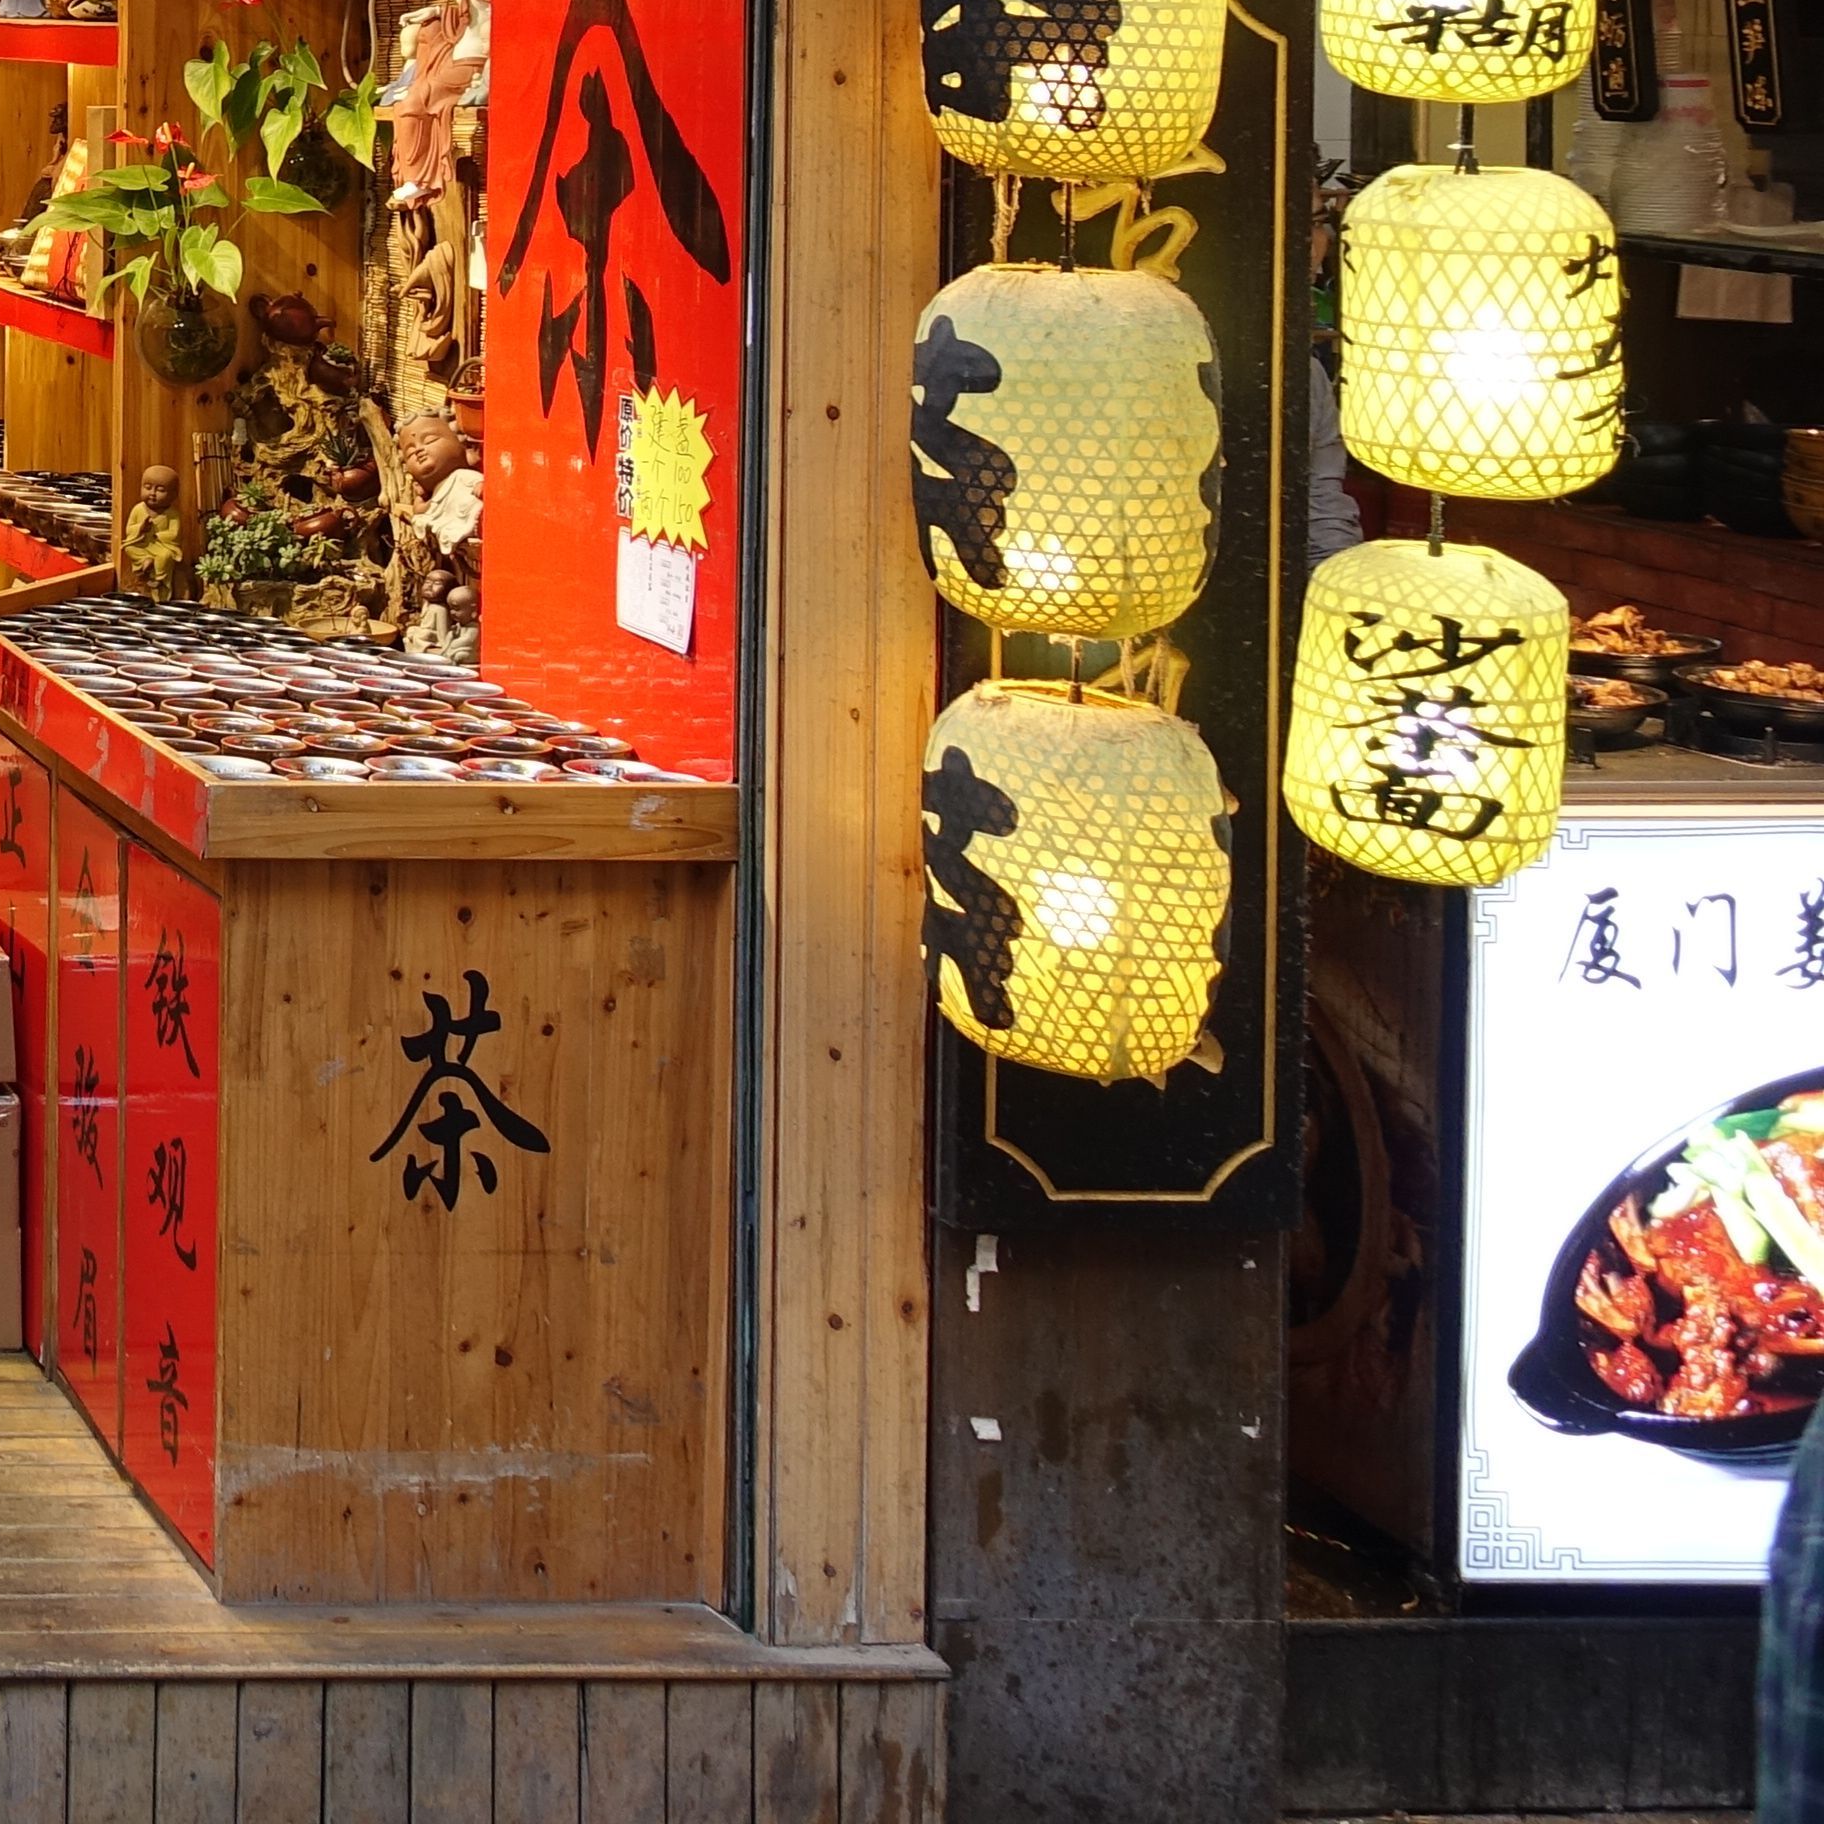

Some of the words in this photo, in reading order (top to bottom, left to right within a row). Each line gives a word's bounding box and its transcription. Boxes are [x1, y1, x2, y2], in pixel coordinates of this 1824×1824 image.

[145, 926, 201, 1468] 铁观音
[370, 968, 550, 1213] 茶
